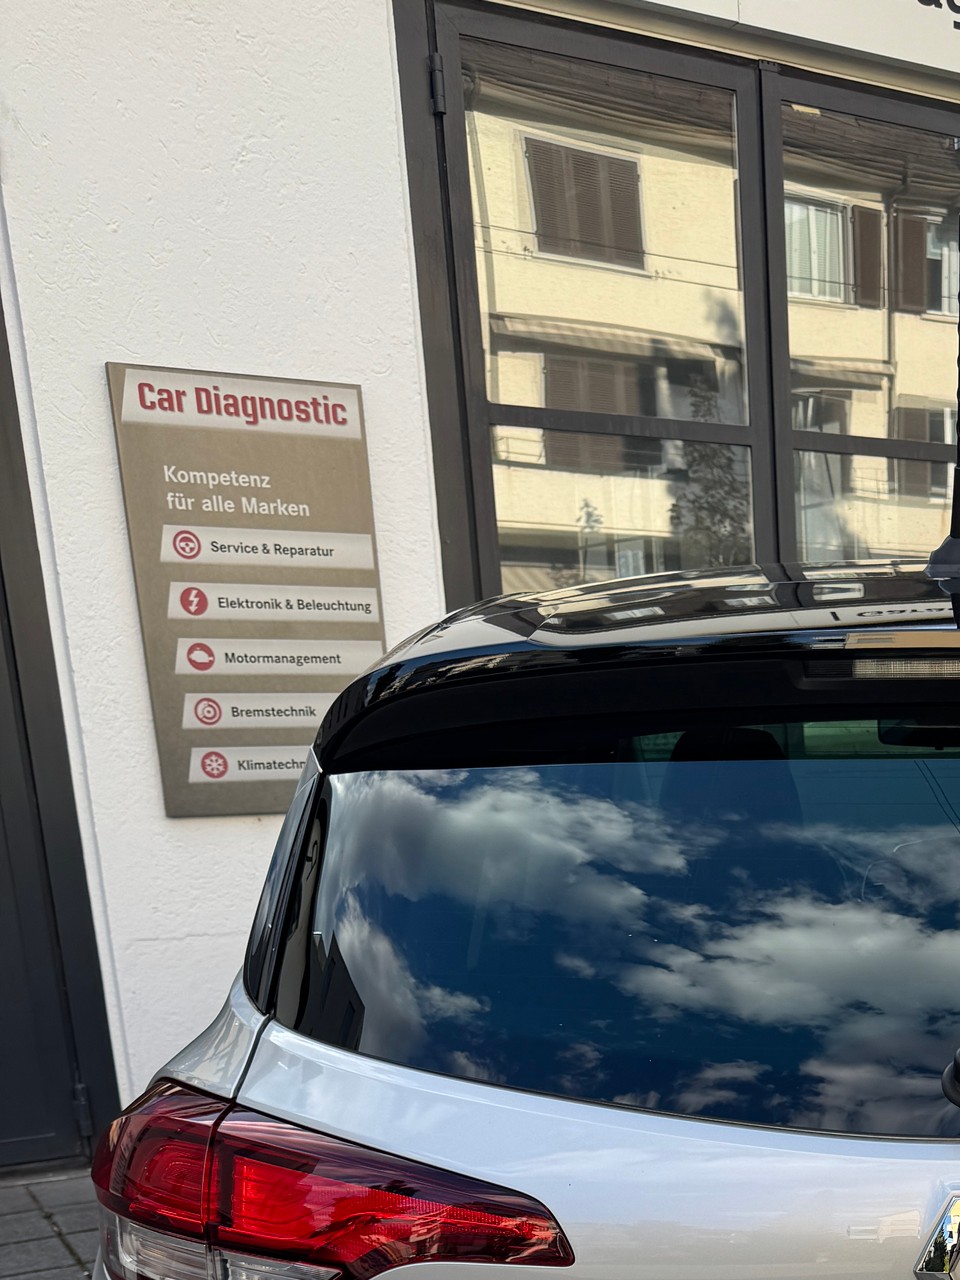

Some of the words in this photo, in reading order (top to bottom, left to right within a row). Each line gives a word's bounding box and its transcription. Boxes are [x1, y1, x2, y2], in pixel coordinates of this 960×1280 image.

[137, 381, 187, 413] Car
[195, 385, 348, 426] Diagnostic
[163, 464, 271, 490] Kompetenz
[166, 493, 195, 511] für
[201, 496, 235, 513] alle
[241, 497, 310, 517] Marken
[210, 540, 259, 556] Service
[262, 543, 271, 556] &
[274, 543, 335, 560] Reparatur
[217, 596, 283, 611] Elektronik
[285, 599, 294, 611] &
[296, 598, 372, 615] Beleuchtung
[224, 652, 342, 667] Motormanagement
[230, 704, 317, 719] Bremstechnik
